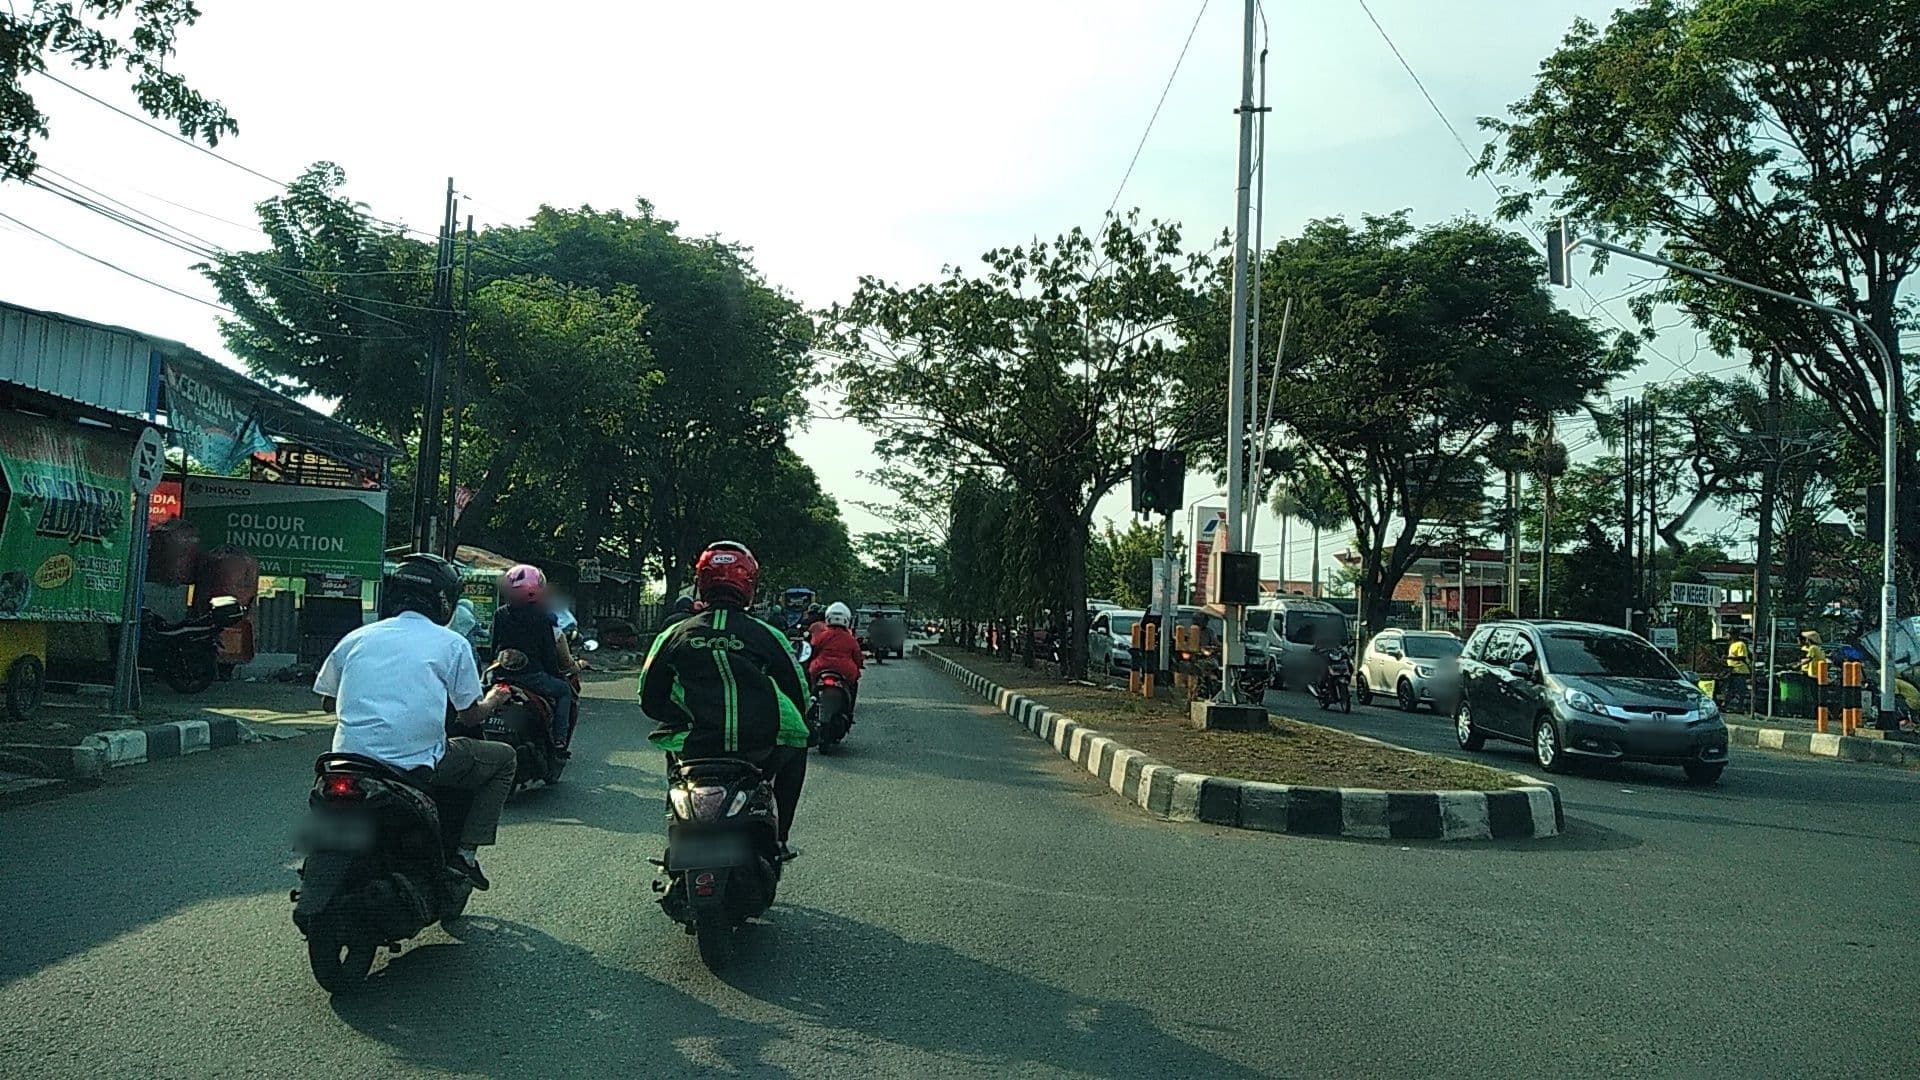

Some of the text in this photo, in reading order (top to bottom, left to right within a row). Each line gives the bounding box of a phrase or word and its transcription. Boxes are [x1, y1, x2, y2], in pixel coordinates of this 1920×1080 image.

[179, 374, 234, 421] CENDANA
[205, 485, 251, 496] INDACO
[227, 512, 305, 532] COLOUR
[226, 530, 344, 552] INNOVATION
[1673, 584, 1686, 602] SMP
[1687, 585, 1709, 604] NEGERI
[690, 634, 745, 651] Grab
